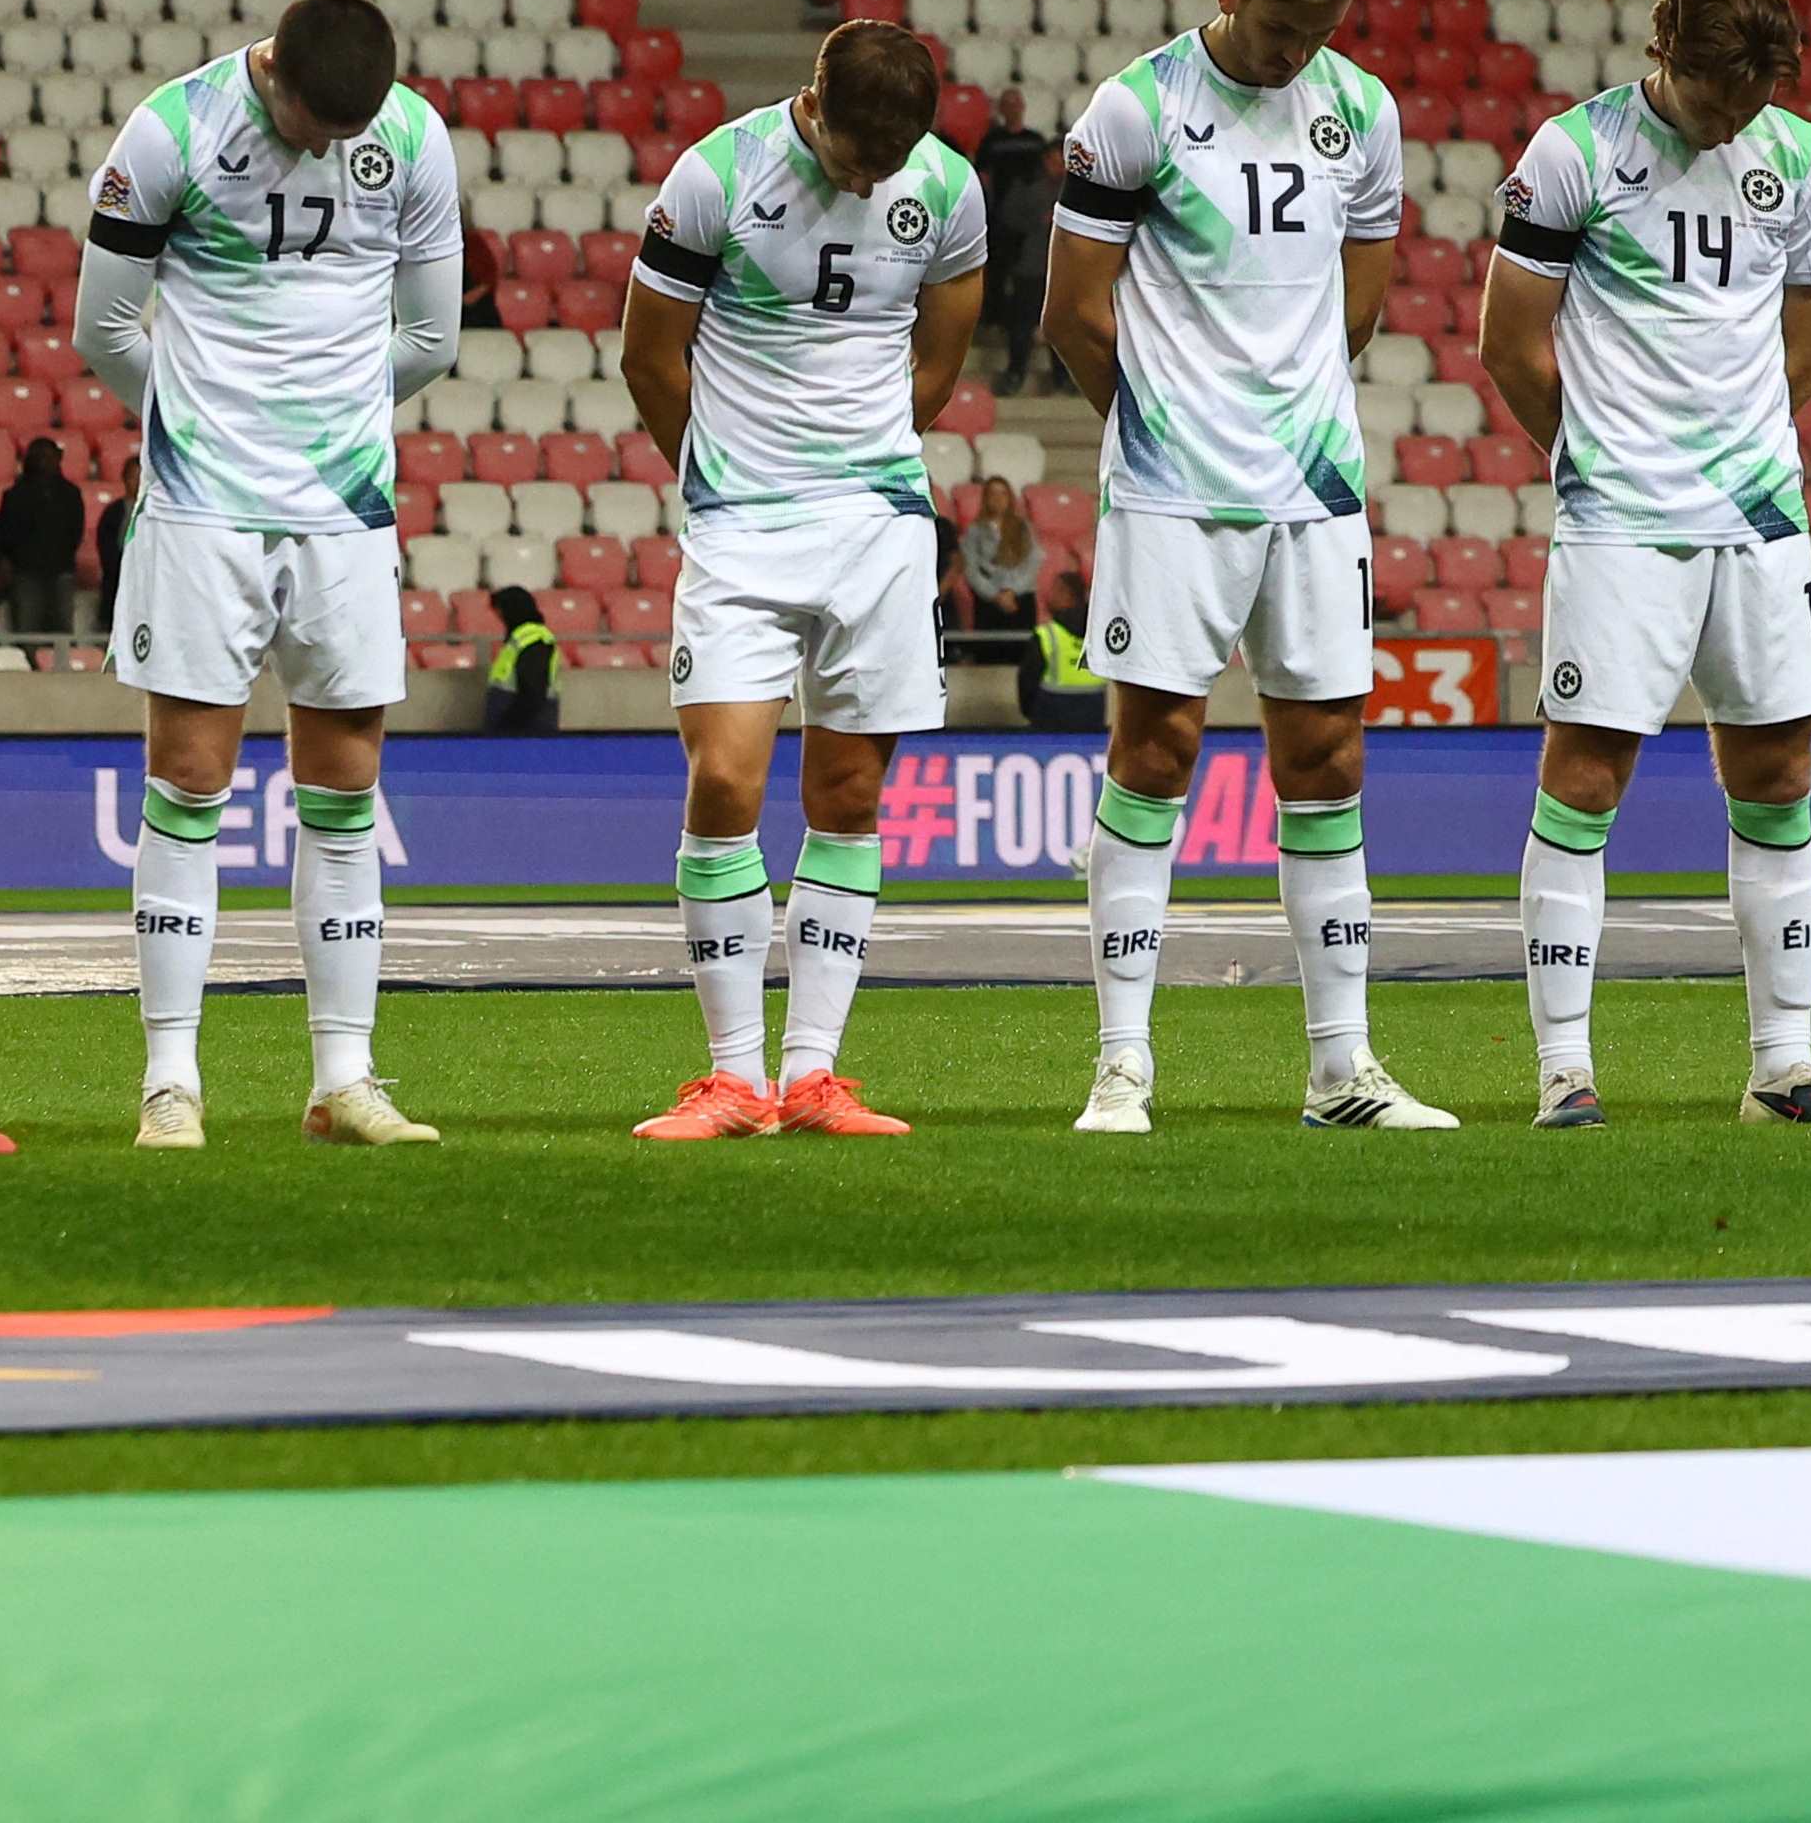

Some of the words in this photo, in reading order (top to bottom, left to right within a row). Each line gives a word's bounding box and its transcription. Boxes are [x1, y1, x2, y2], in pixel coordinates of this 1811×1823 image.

[265, 193, 335, 261] 17
[1240, 162, 1306, 235] 12
[812, 243, 855, 313] 6
[1667, 210, 1732, 287] 14
[135, 910, 203, 936] ÉIRE
[689, 935, 744, 963] IRE
[1528, 938, 1590, 967] ÉIRE
